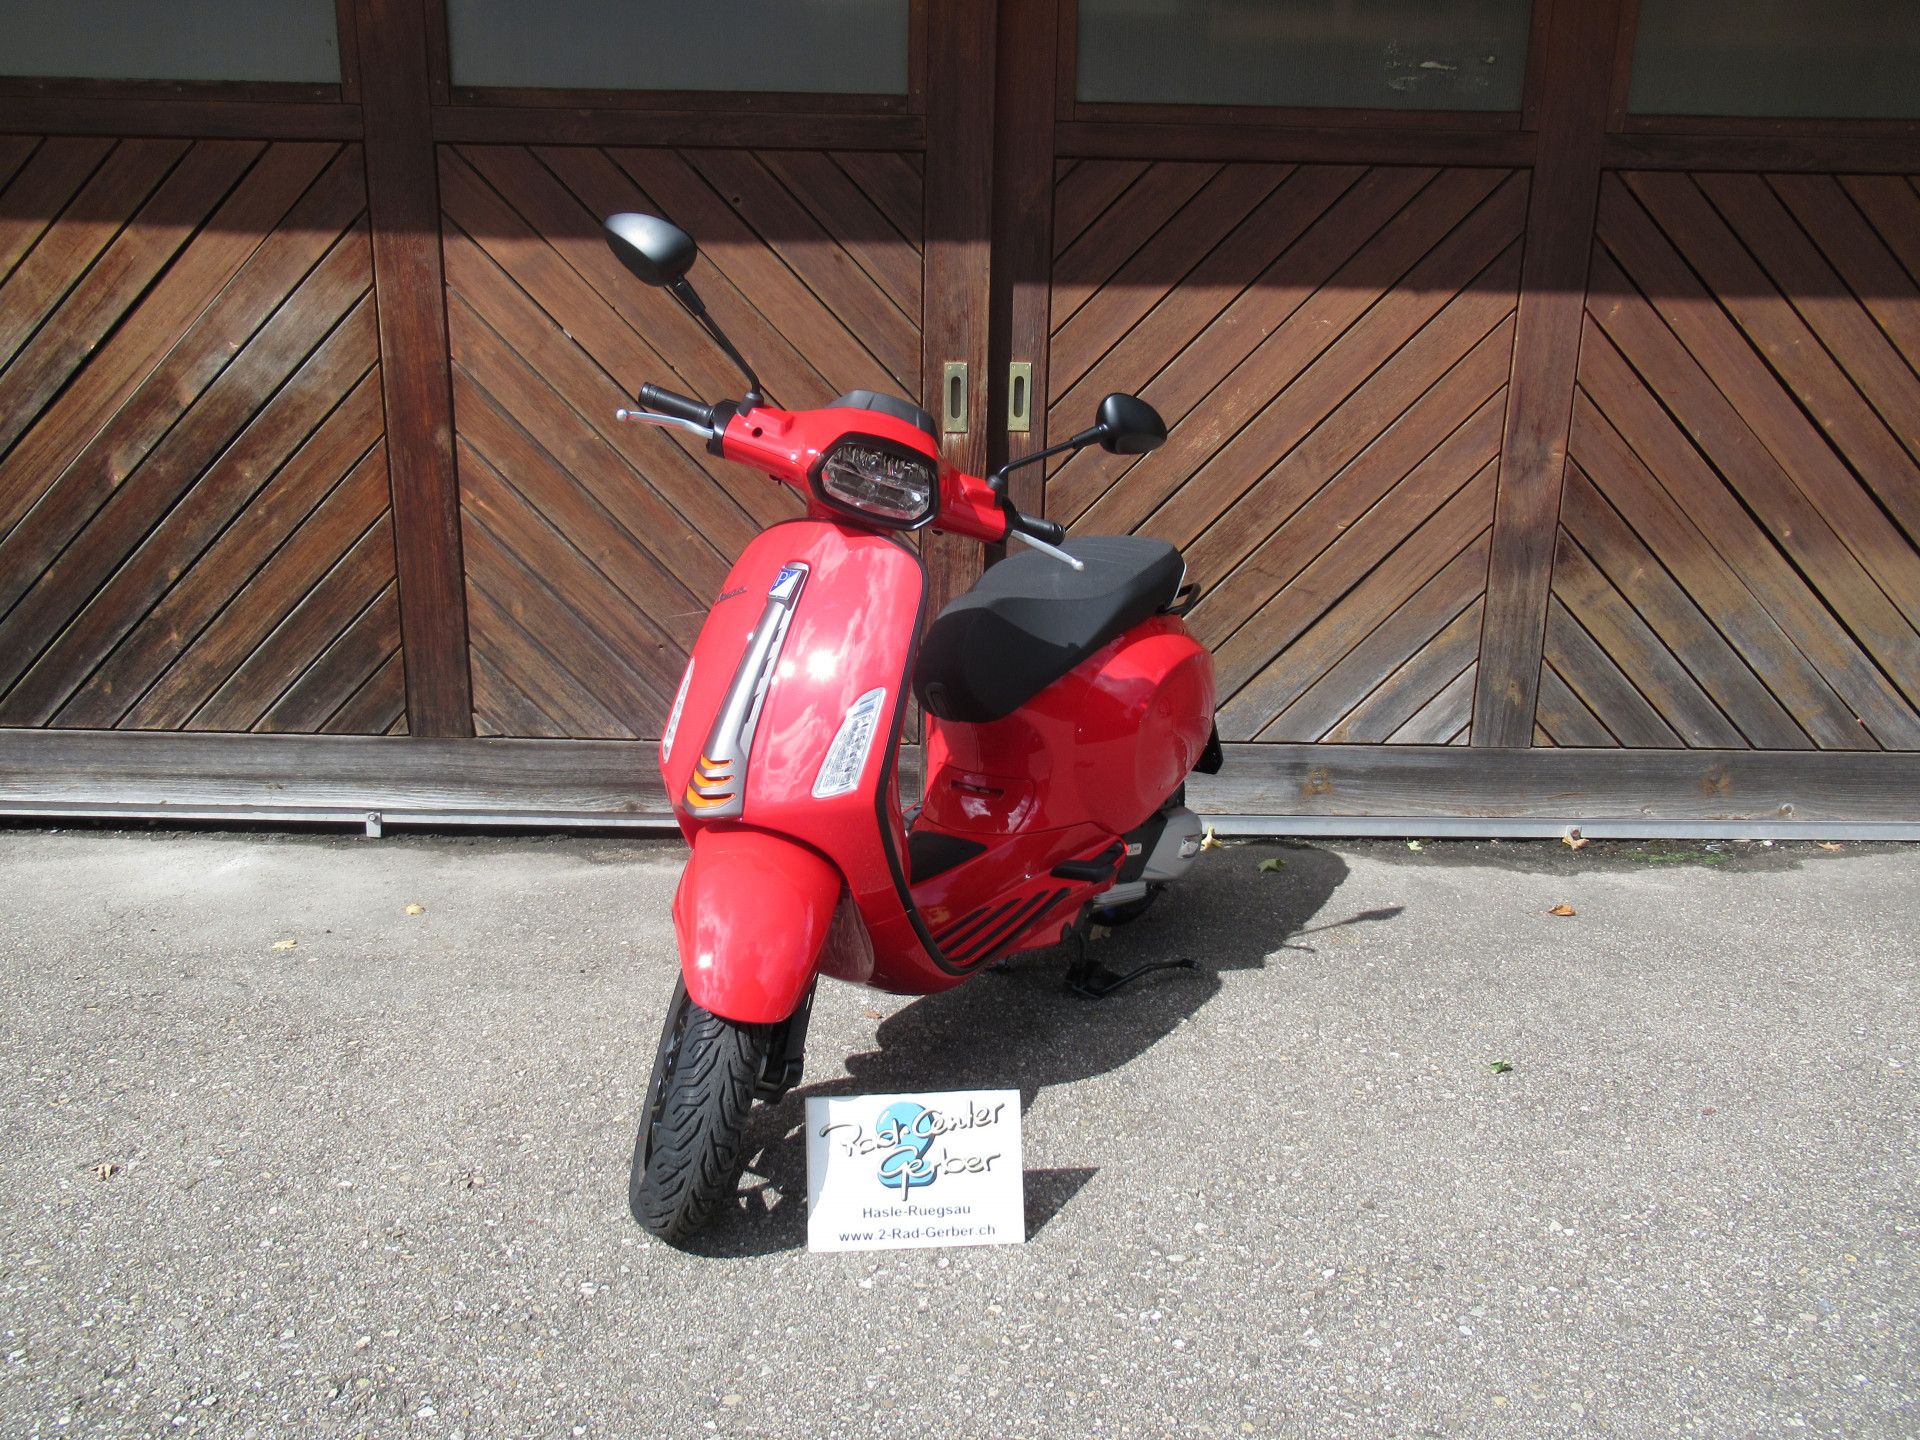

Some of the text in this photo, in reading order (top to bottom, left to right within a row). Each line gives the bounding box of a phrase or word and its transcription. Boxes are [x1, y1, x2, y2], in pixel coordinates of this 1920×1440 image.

[774, 571, 789, 587] P
[911, 1100, 1005, 1139] Center
[877, 1145, 1002, 1202] Gerber
[862, 1204, 972, 1219] Hasle-Rüegsau
[838, 1224, 997, 1242] www.2-Rad-Gerber.ch
